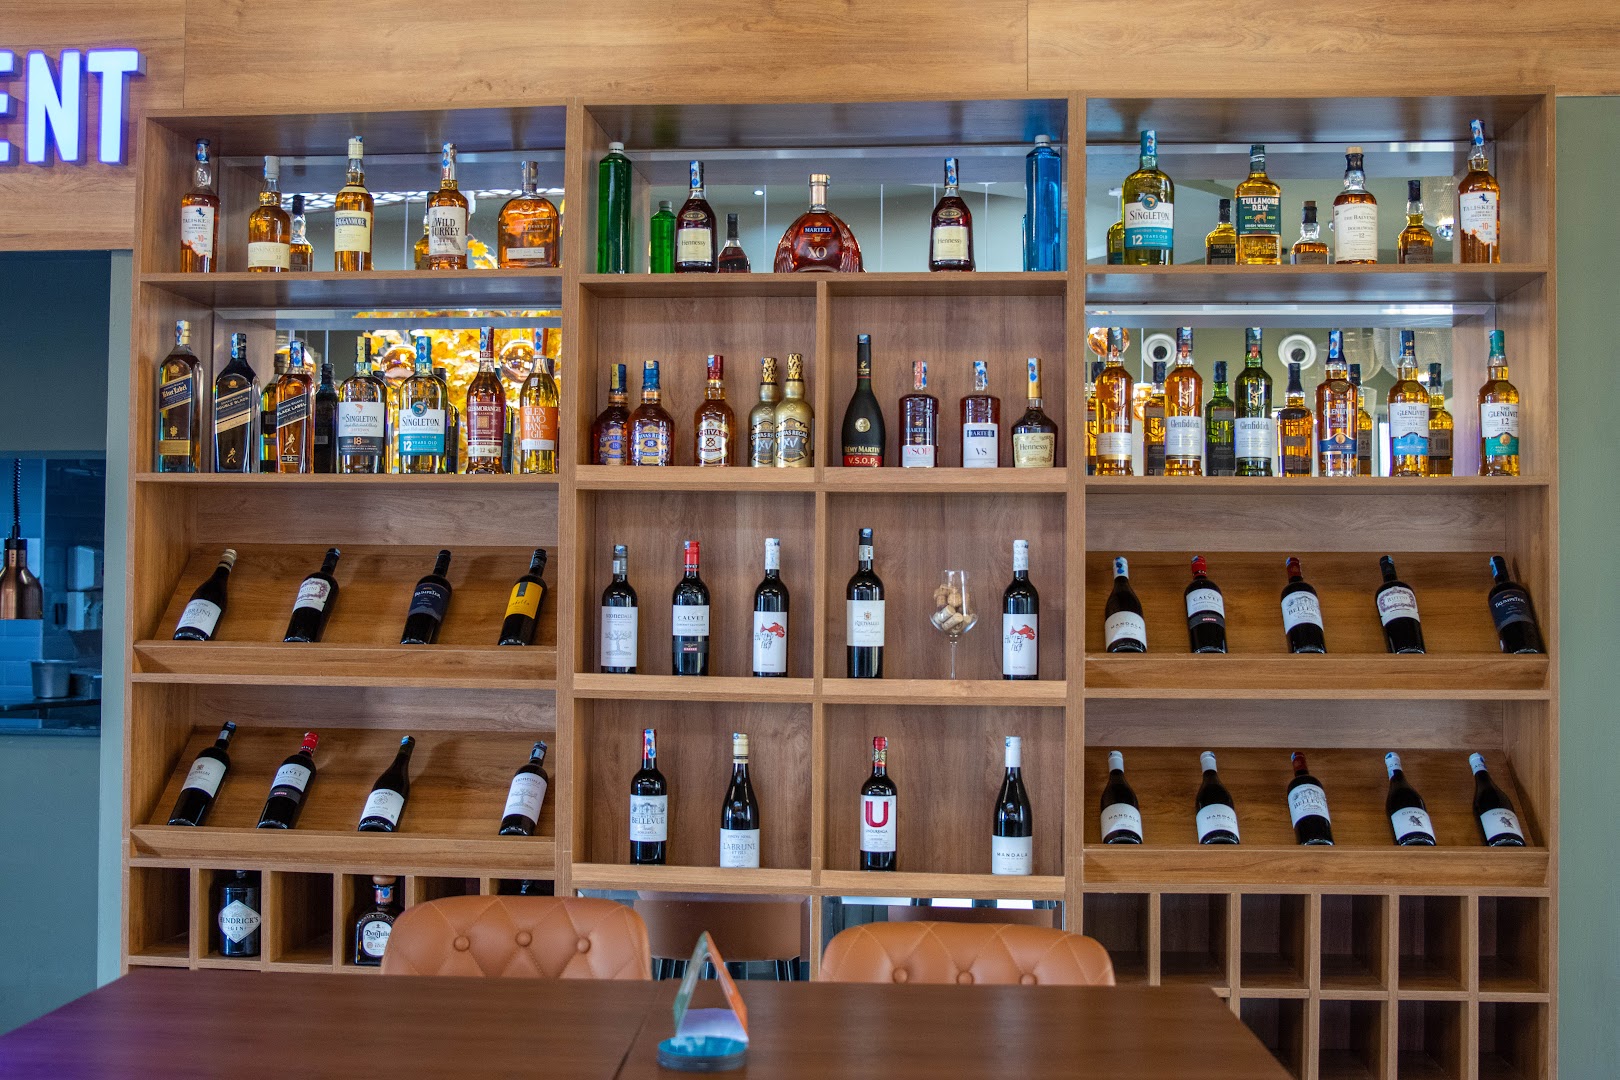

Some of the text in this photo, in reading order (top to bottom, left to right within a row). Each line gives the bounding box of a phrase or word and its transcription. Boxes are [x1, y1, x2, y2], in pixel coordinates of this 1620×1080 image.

[1130, 210, 1170, 220] SINGLETON
[434, 218, 456, 226] WILD
[1482, 222, 1488, 230] 10
[432, 226, 460, 236] TURKEY
[1132, 234, 1142, 246] 12
[808, 246, 827, 258] XO
[525, 407, 545, 416] GLEN
[346, 414, 378, 422] SINGLETON
[402, 417, 440, 426] SINGLETON
[403, 440, 412, 451] 12
[865, 801, 888, 828] U
[632, 816, 665, 824] BELLEVUE
